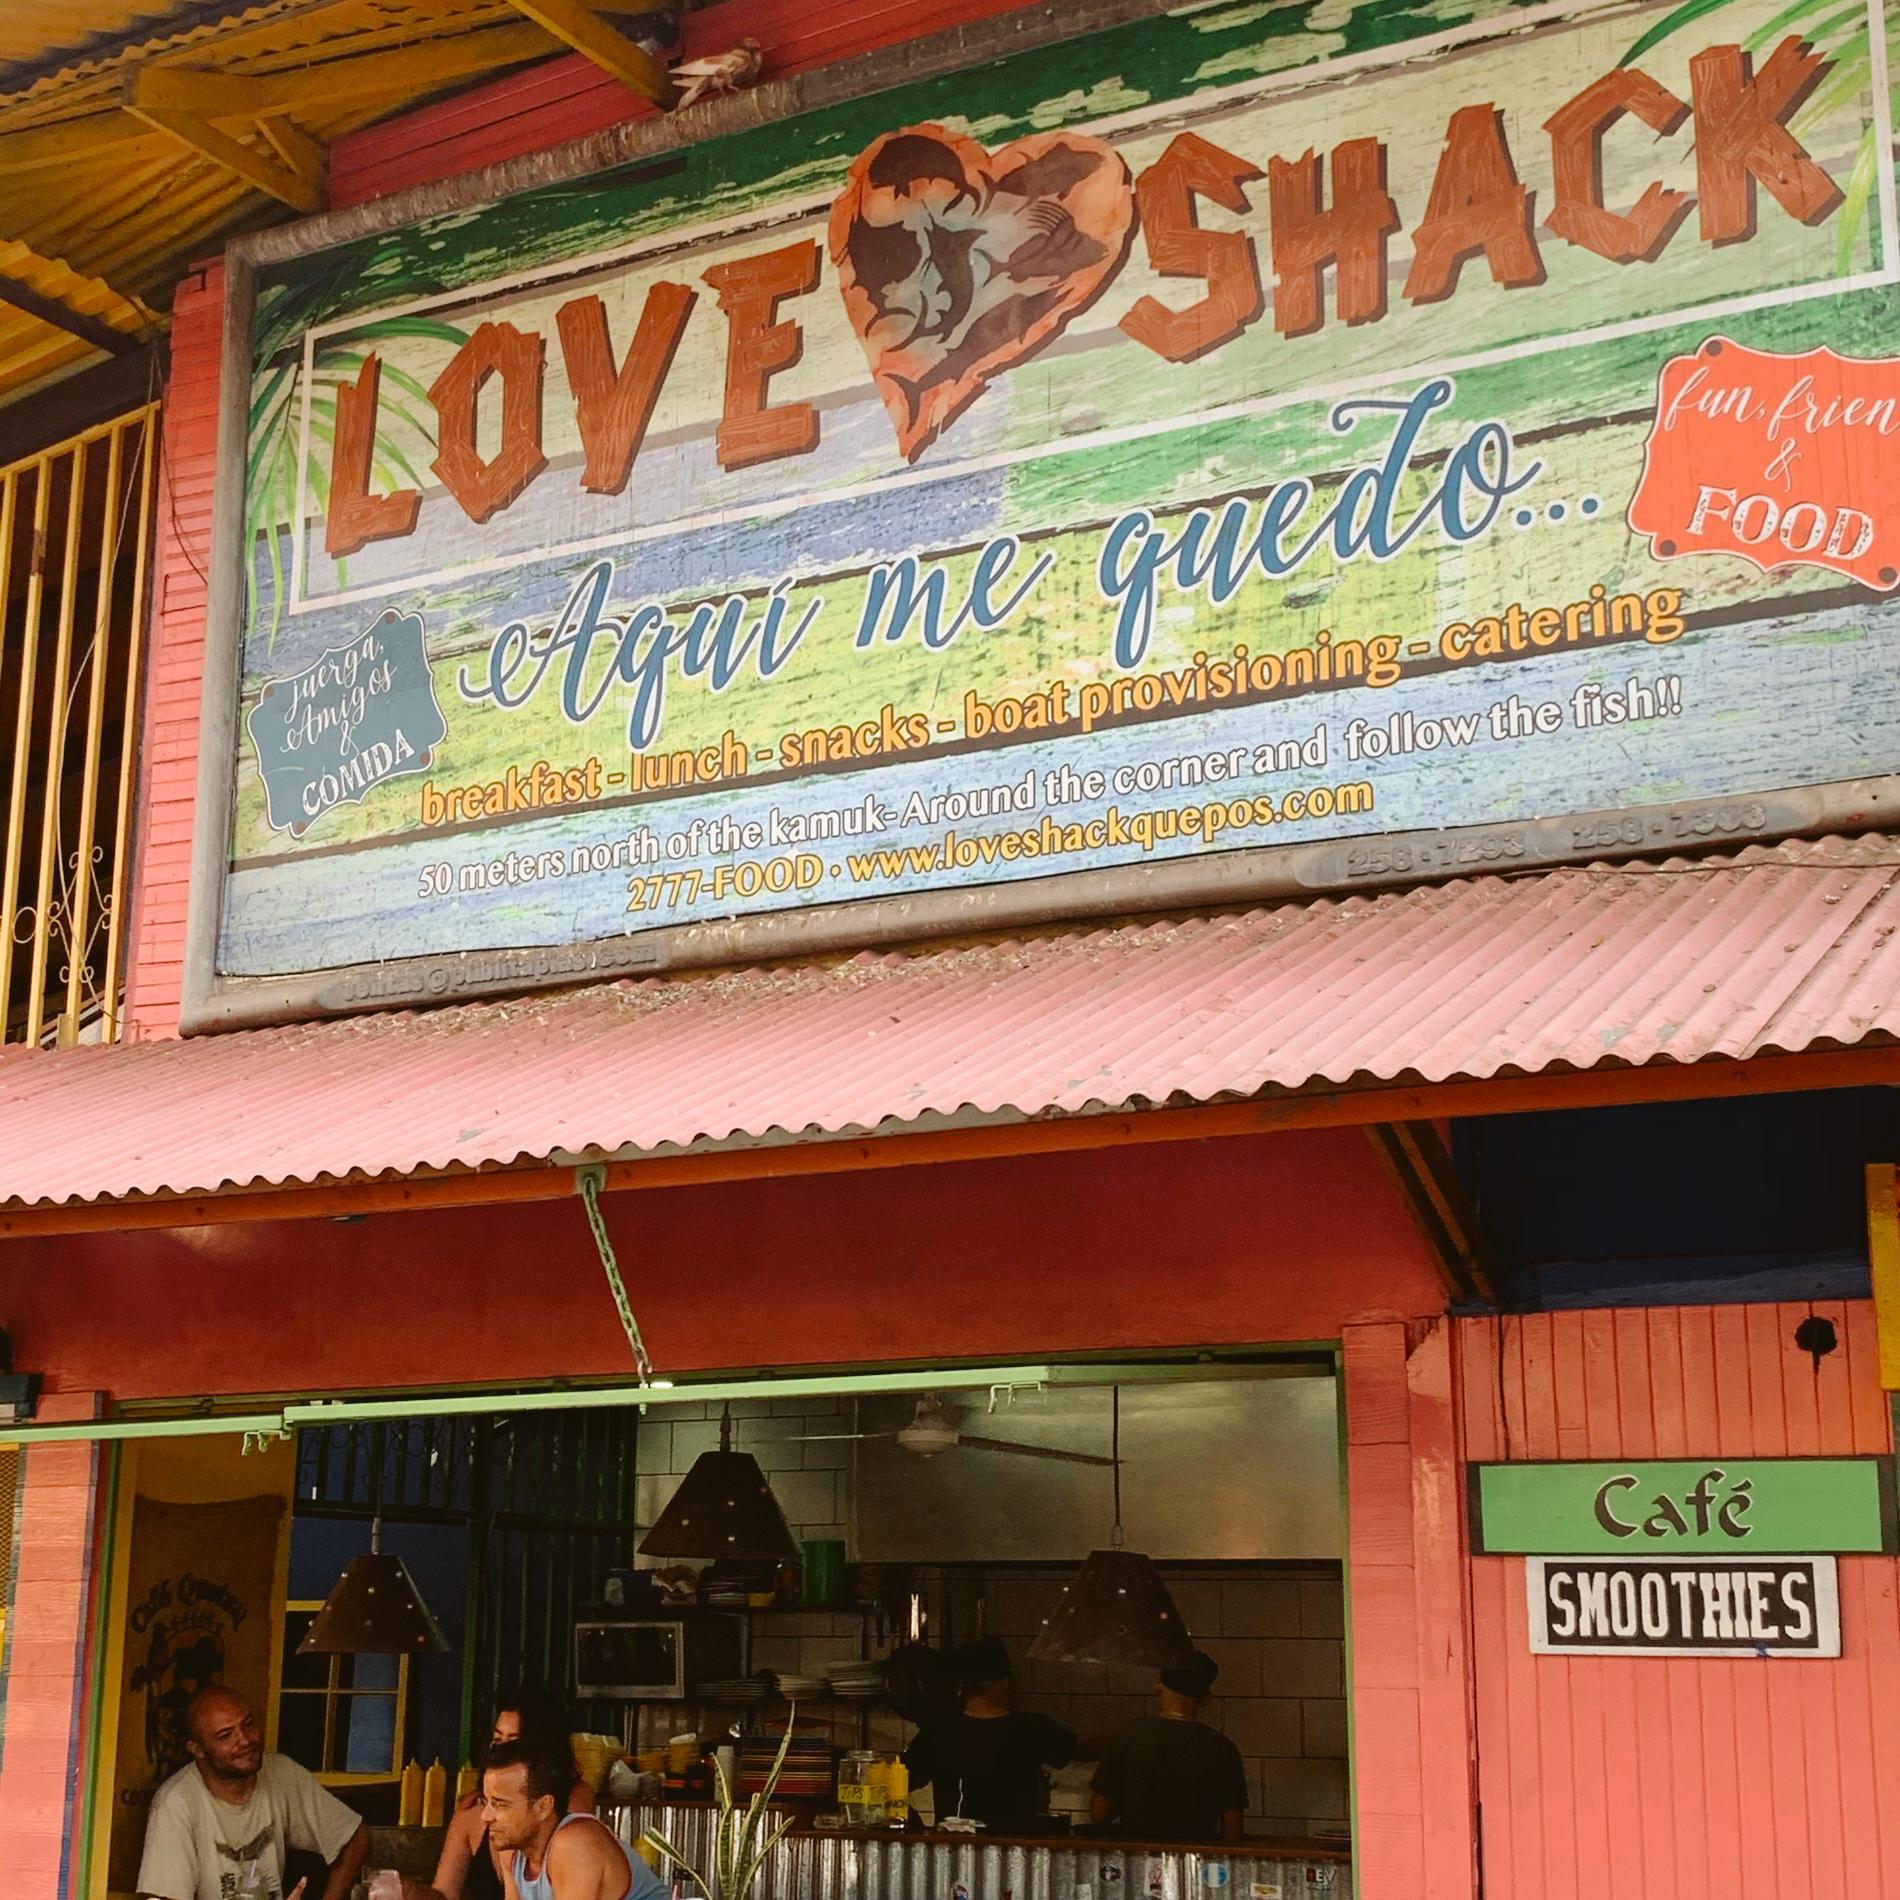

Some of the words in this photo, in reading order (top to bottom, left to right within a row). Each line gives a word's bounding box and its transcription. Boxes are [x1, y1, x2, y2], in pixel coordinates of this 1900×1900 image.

[326, 239, 822, 558] LOVE
[1118, 33, 1845, 363] SHACK
[1664, 366, 1765, 431] fun,
[1764, 438, 1802, 492] &
[1686, 484, 1874, 560] FOOD
[857, 540, 1052, 648] me
[280, 660, 397, 752] Amigos
[340, 720, 359, 756] &
[420, 757, 601, 827] breakfast
[631, 730, 748, 792] lunch
[779, 704, 930, 768] snacks
[965, 680, 1070, 739] boat
[1080, 629, 1402, 733] provisioning
[1440, 583, 1686, 644] catering
[302, 729, 415, 816] COMIDA
[418, 862, 453, 898] 50
[459, 849, 565, 892] meters
[572, 826, 659, 875] north
[667, 819, 706, 858] of
[707, 815, 763, 853] the
[1044, 763, 1105, 806] the
[1113, 747, 1247, 794] corner
[1253, 723, 1327, 775] and
[1344, 710, 1480, 761] follow
[1489, 694, 1563, 741] the
[1570, 675, 1683, 729] fish!!
[626, 853, 823, 912] 2777-FOOD
[847, 781, 1374, 882] www.loveshackquepos.com
[1594, 1469, 1754, 1539] Café
[1549, 1570, 1812, 1640] SMOOTHIES
